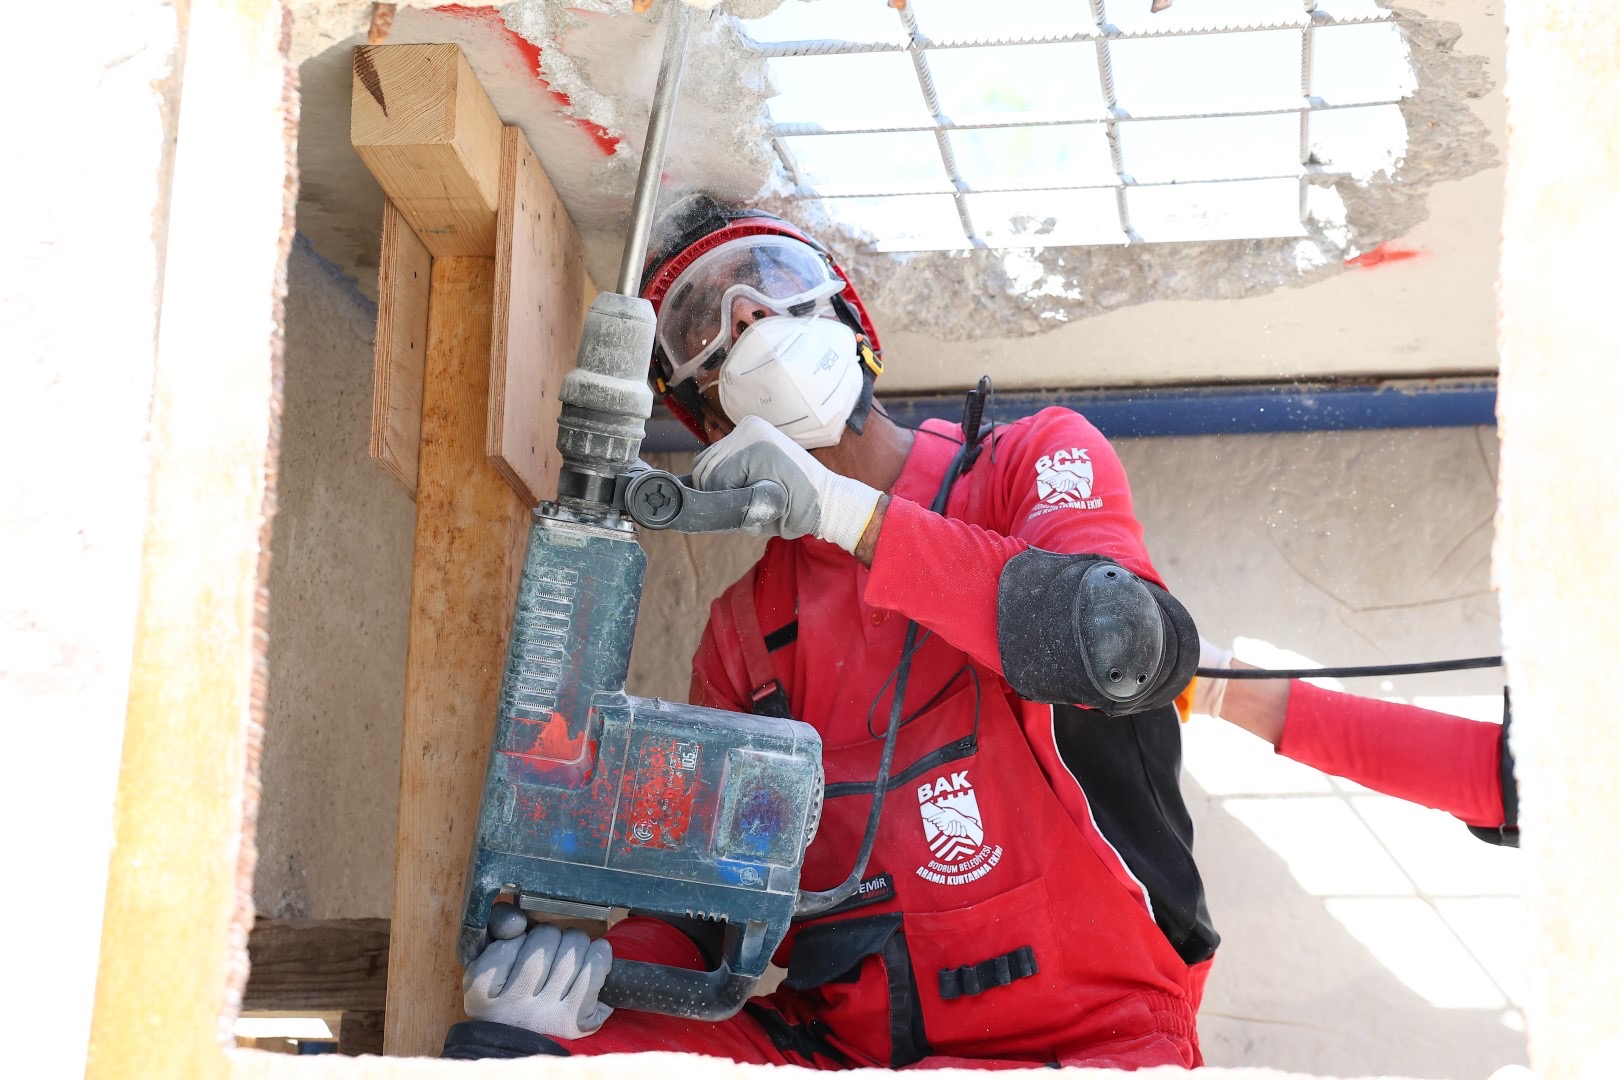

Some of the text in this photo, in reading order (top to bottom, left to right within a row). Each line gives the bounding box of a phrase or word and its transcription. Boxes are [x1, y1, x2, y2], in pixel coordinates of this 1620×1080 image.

[1035, 448, 1091, 475] BAK
[917, 770, 972, 804] BAK
[916, 866, 946, 885] ARAMA
[947, 863, 993, 885] KURTARMA
[928, 860, 958, 874] BODRUM
[852, 877, 887, 896] EMİR
